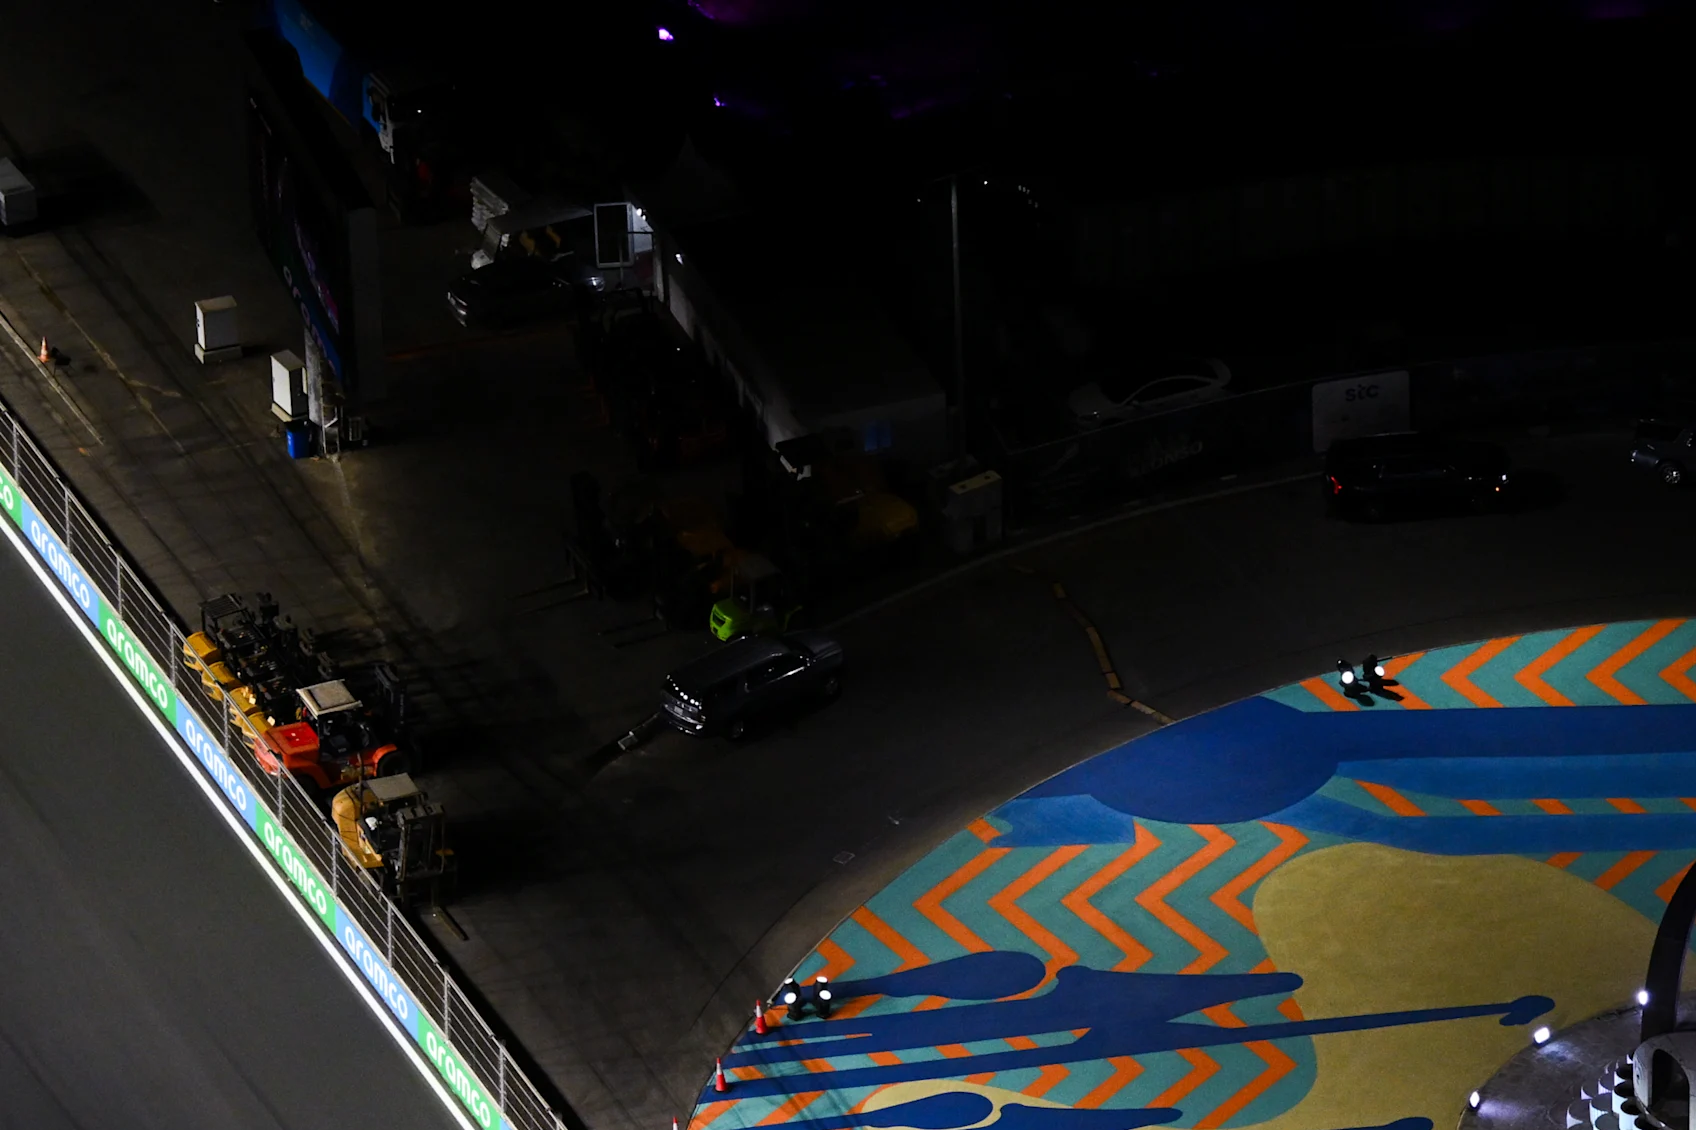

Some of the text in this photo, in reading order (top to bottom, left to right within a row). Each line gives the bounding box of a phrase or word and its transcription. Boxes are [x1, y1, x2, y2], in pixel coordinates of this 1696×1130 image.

[1345, 383, 1380, 402] stc
[31, 520, 90, 609] aramco
[107, 618, 168, 709] aramco
[185, 718, 247, 812] aramco
[264, 821, 327, 915] aramco
[344, 926, 409, 1021] aramco
[426, 1031, 492, 1129] aramco
